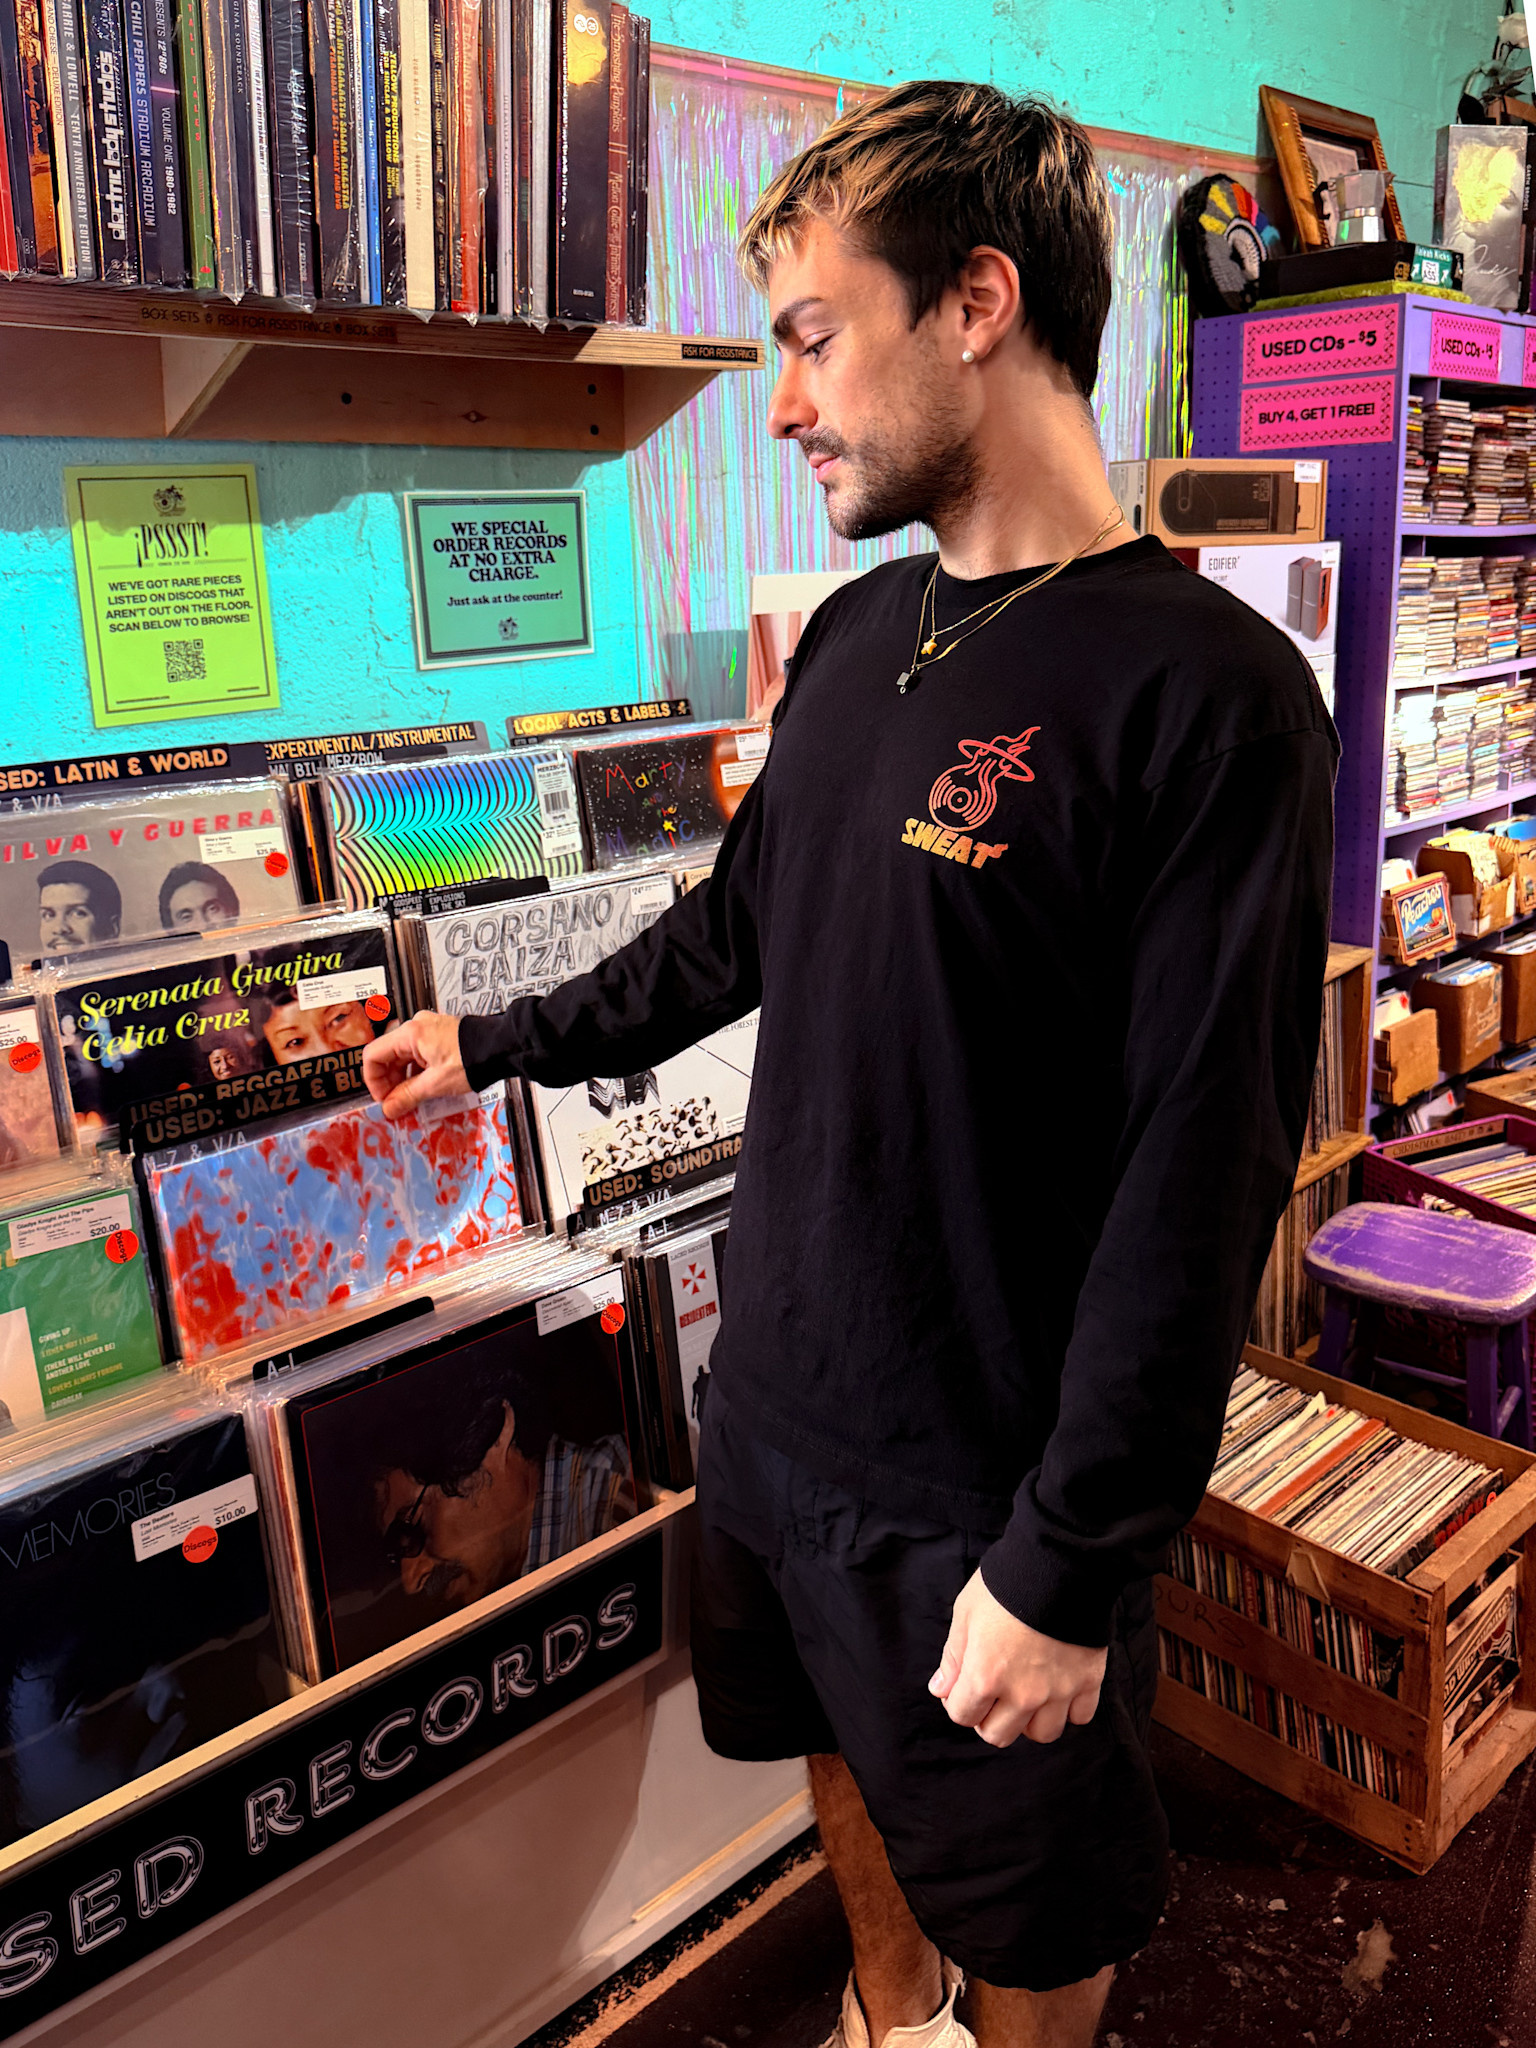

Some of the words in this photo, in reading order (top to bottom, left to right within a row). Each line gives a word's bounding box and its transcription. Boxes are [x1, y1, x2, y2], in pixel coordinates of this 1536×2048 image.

[130, 1, 143, 36] CHILI
[612, 14, 625, 31] The
[66, 43, 75, 51] &
[463, 23, 472, 89] FLAMING
[612, 32, 625, 83] Smashing
[66, 56, 79, 101] LOWELL
[133, 39, 146, 95] PEPPERS
[235, 33, 243, 94] SOUNDTRACK
[390, 53, 399, 94] YELLOW
[52, 67, 60, 95] DELUXE
[97, 50, 118, 126] studios
[54, 96, 62, 126] EDITION
[384, 108, 391, 116] &
[385, 117, 391, 128] DJ
[463, 95, 473, 127] LIPS
[611, 83, 625, 133] Pumpkins
[71, 114, 81, 147] TENTH
[137, 98, 151, 157] STADIUM
[162, 107, 172, 142] VOLUME
[339, 121, 348, 153] SOLAR
[391, 95, 400, 163] PRODUCTIONS
[102, 126, 124, 166] lady
[164, 145, 173, 163] ONE
[73, 150, 87, 220] ANNIVERSARY
[141, 160, 156, 226] ARCADIUM
[165, 165, 177, 215] 1980-1982
[611, 172, 621, 204] Mellon
[103, 169, 125, 240] electric
[609, 205, 620, 228] Collie
[79, 224, 90, 262] EDITION
[610, 243, 621, 277] Infinite
[606, 277, 619, 317] Sadness
[142, 308, 168, 320] BOX
[173, 312, 199, 323] SETS
[218, 314, 239, 325] ASK
[242, 316, 265, 328] FOR
[269, 318, 330, 333] ASSISTANCE
[683, 346, 698, 356] ASK
[699, 347, 714, 357] FOR
[716, 348, 756, 359] ASSISTANCE
[1262, 339, 1305, 358] USED
[1310, 335, 1345, 352] CDs
[1359, 330, 1377, 346] $5
[1441, 337, 1463, 355] USED
[1465, 342, 1480, 358] CDs
[1259, 409, 1286, 425] BUY
[1287, 409, 1298, 423] 4,
[1301, 406, 1327, 420] GET
[1339, 403, 1375, 417] FREE!
[433, 537, 489, 553] ORDER
[494, 535, 567, 550] RECORDS
[451, 522, 478, 536] WE
[482, 520, 548, 535] SPECIAL
[134, 522, 208, 568] ¡PSSST!
[449, 554, 469, 568] AT
[475, 552, 496, 566] NO
[502, 551, 555, 565] EXTRA
[469, 566, 539, 582] CHARGE.
[1208, 556, 1237, 571] EDIFIER
[108, 581, 144, 591] WE'VE
[146, 580, 169, 589] GOT
[172, 578, 201, 587] RARE
[204, 575, 242, 585] PIECES
[108, 594, 147, 605] LISTED
[150, 593, 165, 603] ON
[168, 590, 216, 601] DISCOGS
[218, 588, 245, 598] THAT
[448, 597, 469, 607] Just
[472, 595, 490, 604] ask
[492, 595, 502, 603] at
[505, 593, 520, 603] the
[523, 590, 563, 601] counter!
[106, 608, 145, 619] AREN'T
[148, 606, 171, 616] OUT
[174, 605, 189, 614] ON
[192, 603, 213, 612] THE
[215, 601, 253, 611] FLOOR.
[109, 622, 140, 632] SCAN
[143, 619, 182, 630] BELOW
[184, 618, 199, 626] TO
[201, 614, 250, 624] BROWSE!
[513, 717, 563, 735] LOCAL
[568, 709, 607, 728] ACTS
[610, 708, 621, 723] &
[624, 703, 671, 722] LABELS
[54, 759, 119, 784] LATIN
[128, 757, 143, 776] &
[150, 748, 228, 773] WORLD
[326, 752, 385, 768] MERZBOW
[606, 758, 686, 798] Marty
[12, 797, 23, 813] &
[31, 793, 63, 811] V/A
[108, 828, 127, 847] Y
[143, 807, 276, 842] GUERRA
[901, 818, 1009, 869] SWEAT
[429, 892, 465, 904] EXPLOSIONS
[441, 902, 453, 911] THE
[455, 900, 466, 908] SKY
[1401, 883, 1441, 932] Peaches
[445, 889, 615, 957] CORSANO
[462, 936, 577, 995] BAIZA
[78, 974, 224, 1030] Serenata
[232, 951, 344, 997] Guajira
[356, 989, 378, 998] $25.00
[82, 1024, 168, 1061] Celia
[176, 1007, 250, 1039] Cruz
[12, 1048, 40, 1065] Discogs
[146, 1108, 224, 1144] USED:
[236, 1085, 300, 1119] JAZZ
[310, 1078, 326, 1098] &
[190, 1143, 202, 1160] &
[212, 1131, 247, 1152] V/A
[590, 1174, 643, 1206] USED:
[632, 1200, 642, 1214] &
[646, 1189, 672, 1205] V/A
[90, 1223, 120, 1237] $20.00
[115, 1232, 128, 1263] Discogs
[593, 1297, 615, 1311] $25.00
[679, 1305, 705, 1328] RESIDENT
[706, 1301, 717, 1316] EVIL
[0, 1471, 177, 1570] MEMORIES
[215, 1506, 246, 1525] $10.00
[184, 1536, 217, 1553] Discogs
[244, 1582, 638, 1856] RECORDS
